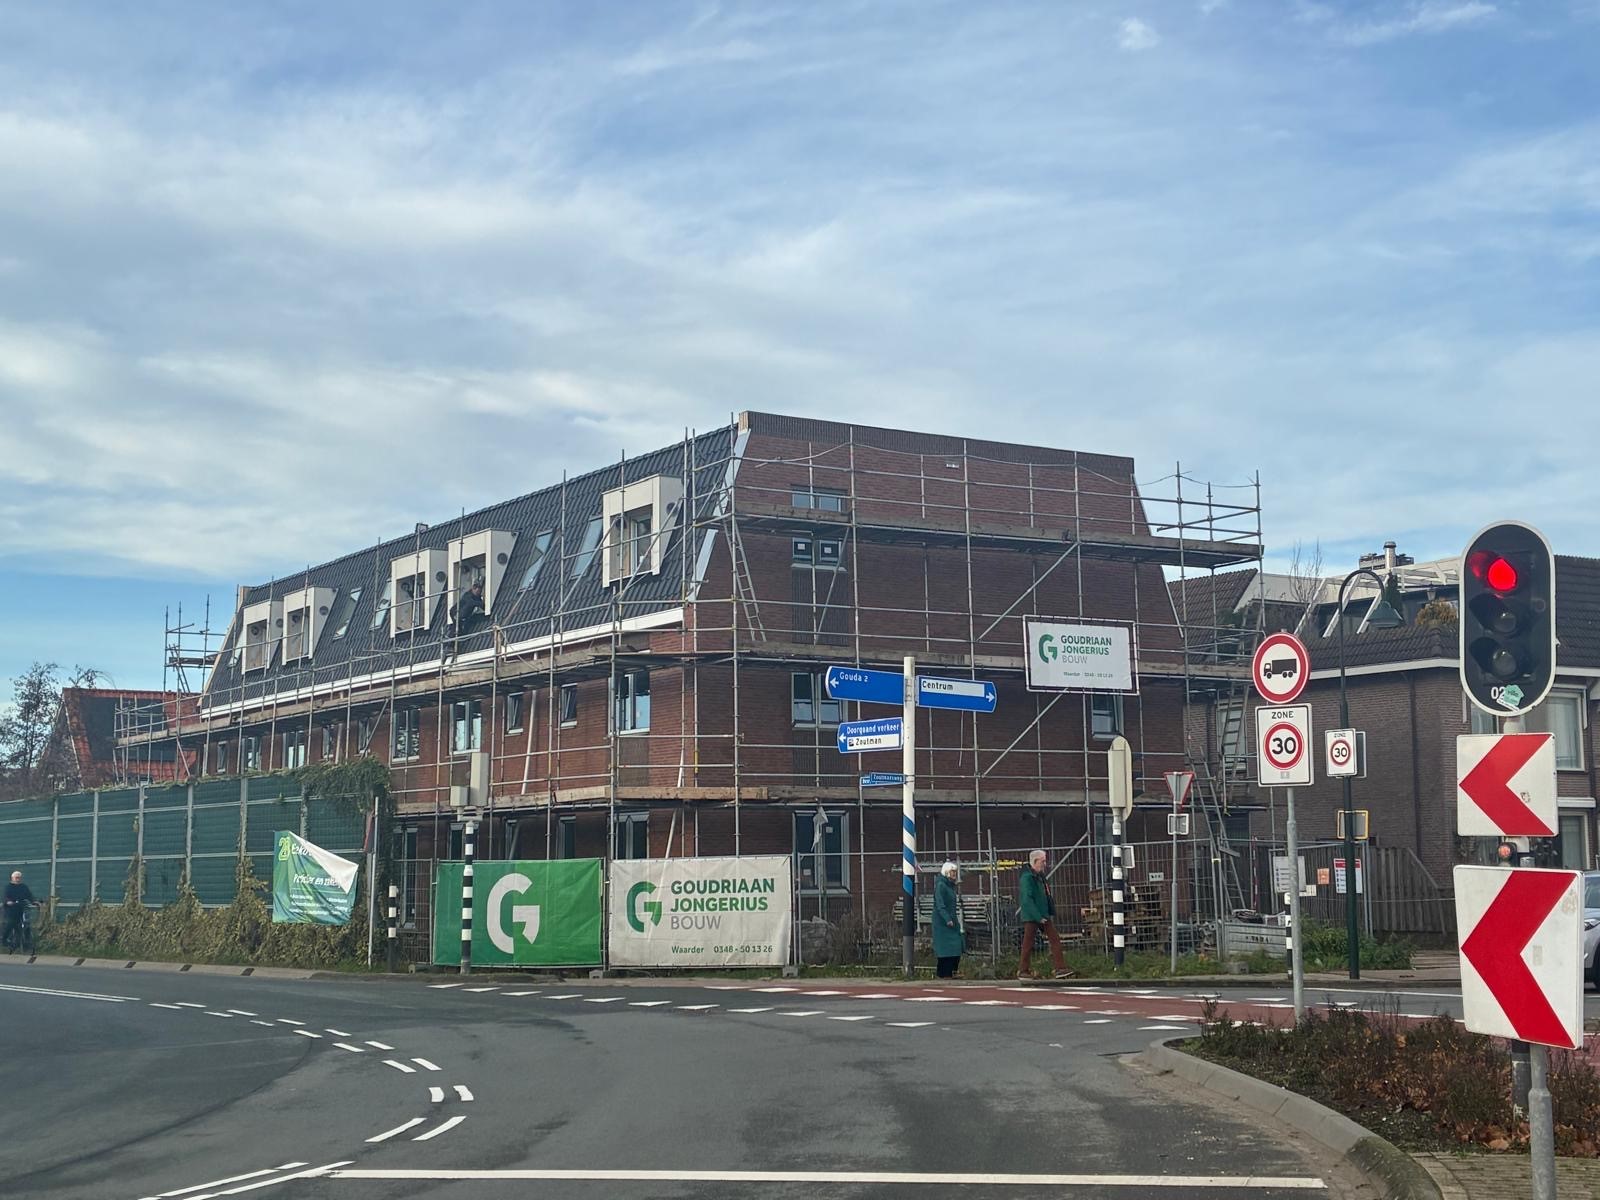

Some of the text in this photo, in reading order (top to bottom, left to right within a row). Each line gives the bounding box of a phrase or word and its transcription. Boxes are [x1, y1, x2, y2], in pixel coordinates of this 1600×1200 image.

[1061, 635, 1112, 646] GOUDRIAAN
[1062, 646, 1109, 655] JONGERIUS
[1062, 655, 1088, 664] BOUW
[839, 671, 869, 683] Gouda 2
[922, 680, 954, 691] Centrum
[1271, 711, 1294, 719] ZONE
[847, 723, 900, 735] Doorgaand verkeer
[855, 738, 882, 746] Zoutman
[1272, 737, 1297, 755] 30
[1334, 747, 1348, 758] 30
[671, 878, 775, 895] GOUDRIAAN
[670, 897, 768, 912] JONGERIUS
[671, 915, 722, 930] BOUW
[671, 945, 704, 954] Waarder
[713, 945, 734, 954] 0348
[739, 945, 750, 953] 50
[752, 945, 762, 953] 13
[763, 945, 773, 953] 26
